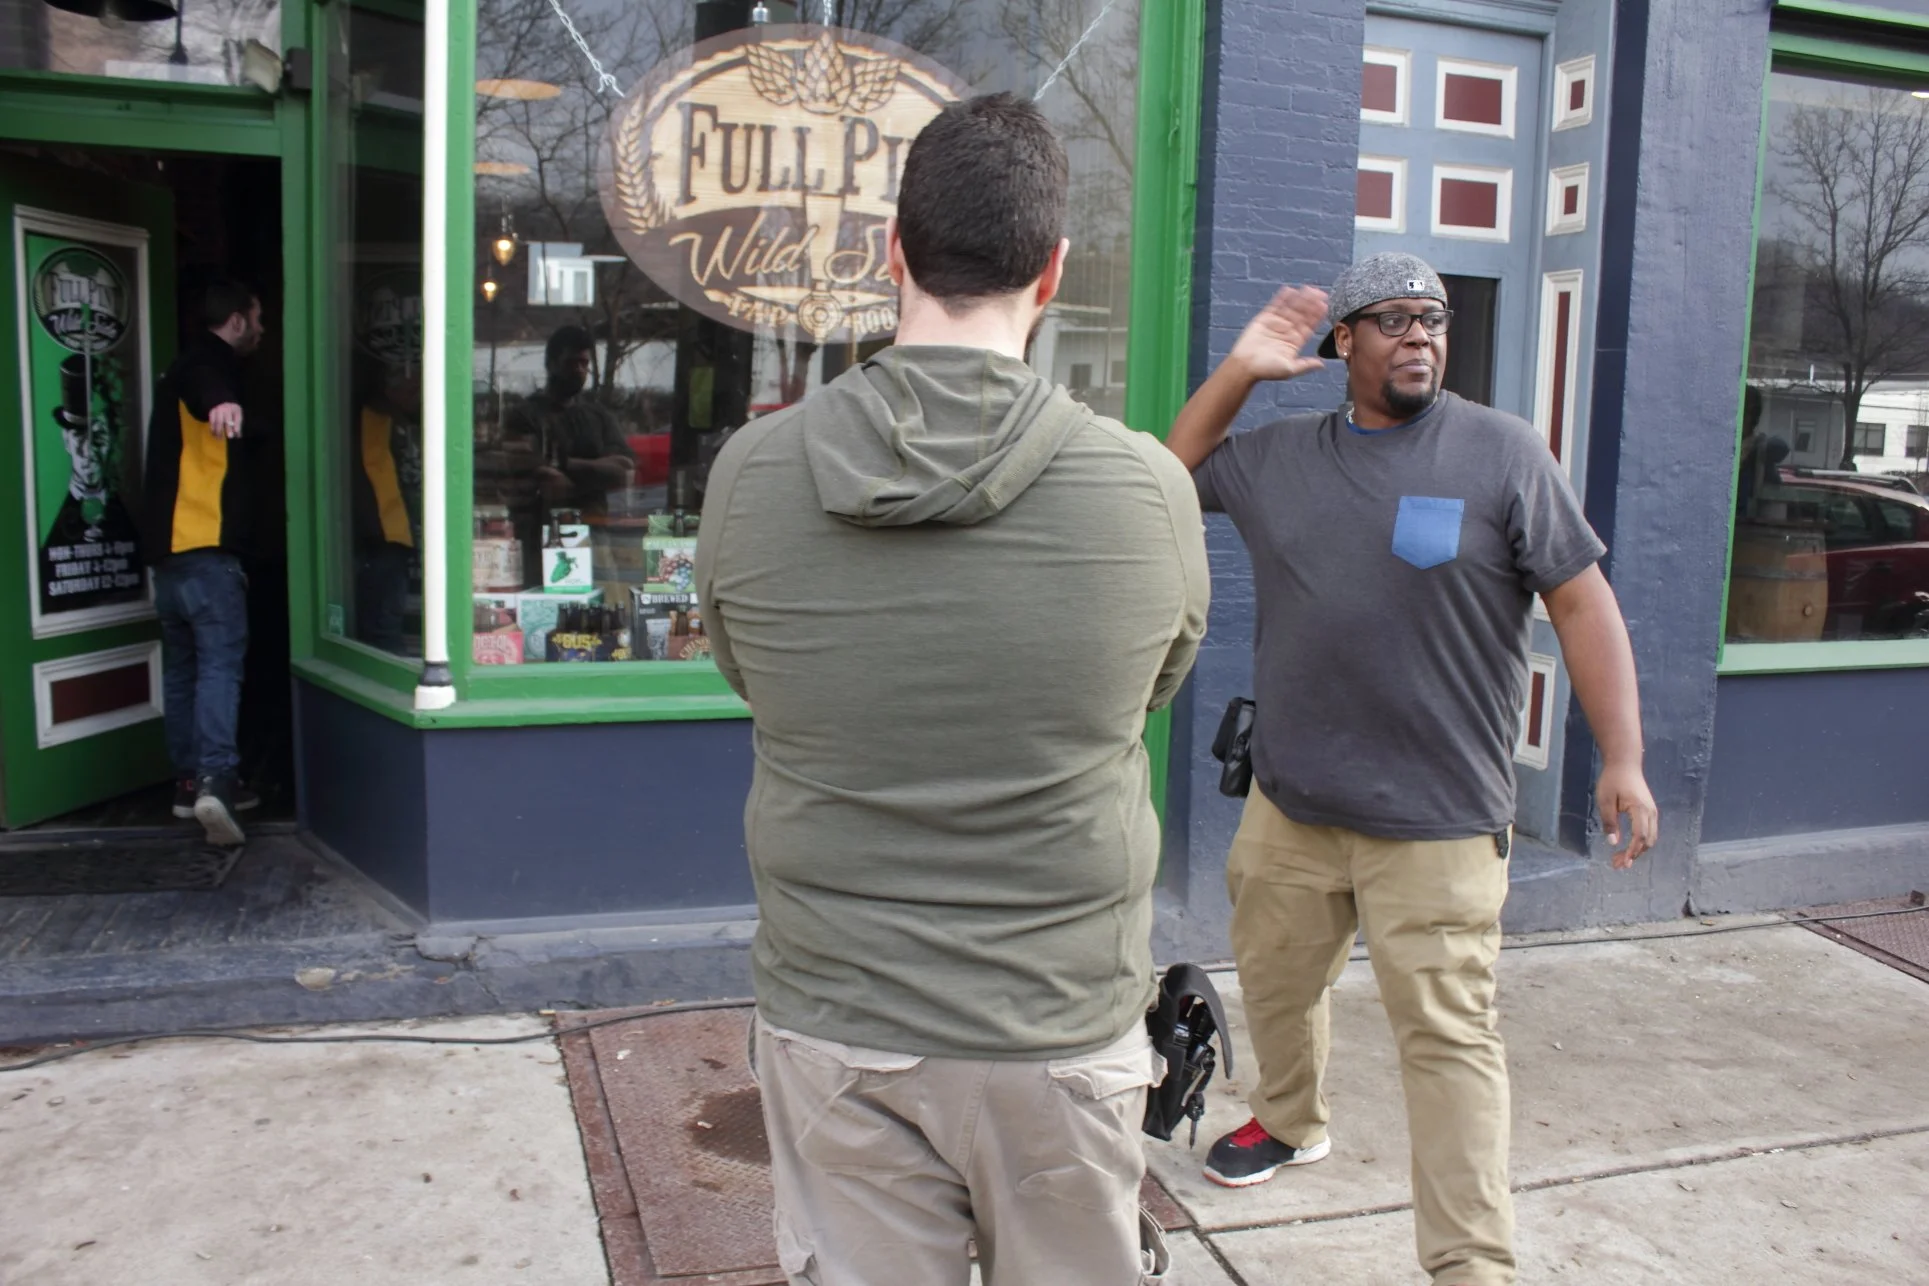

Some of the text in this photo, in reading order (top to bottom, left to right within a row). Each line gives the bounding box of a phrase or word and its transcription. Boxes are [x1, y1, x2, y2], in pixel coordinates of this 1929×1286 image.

[676, 102, 912, 208] FULL PI
[668, 209, 820, 287] Wild
[726, 290, 900, 334] TAP ROO
